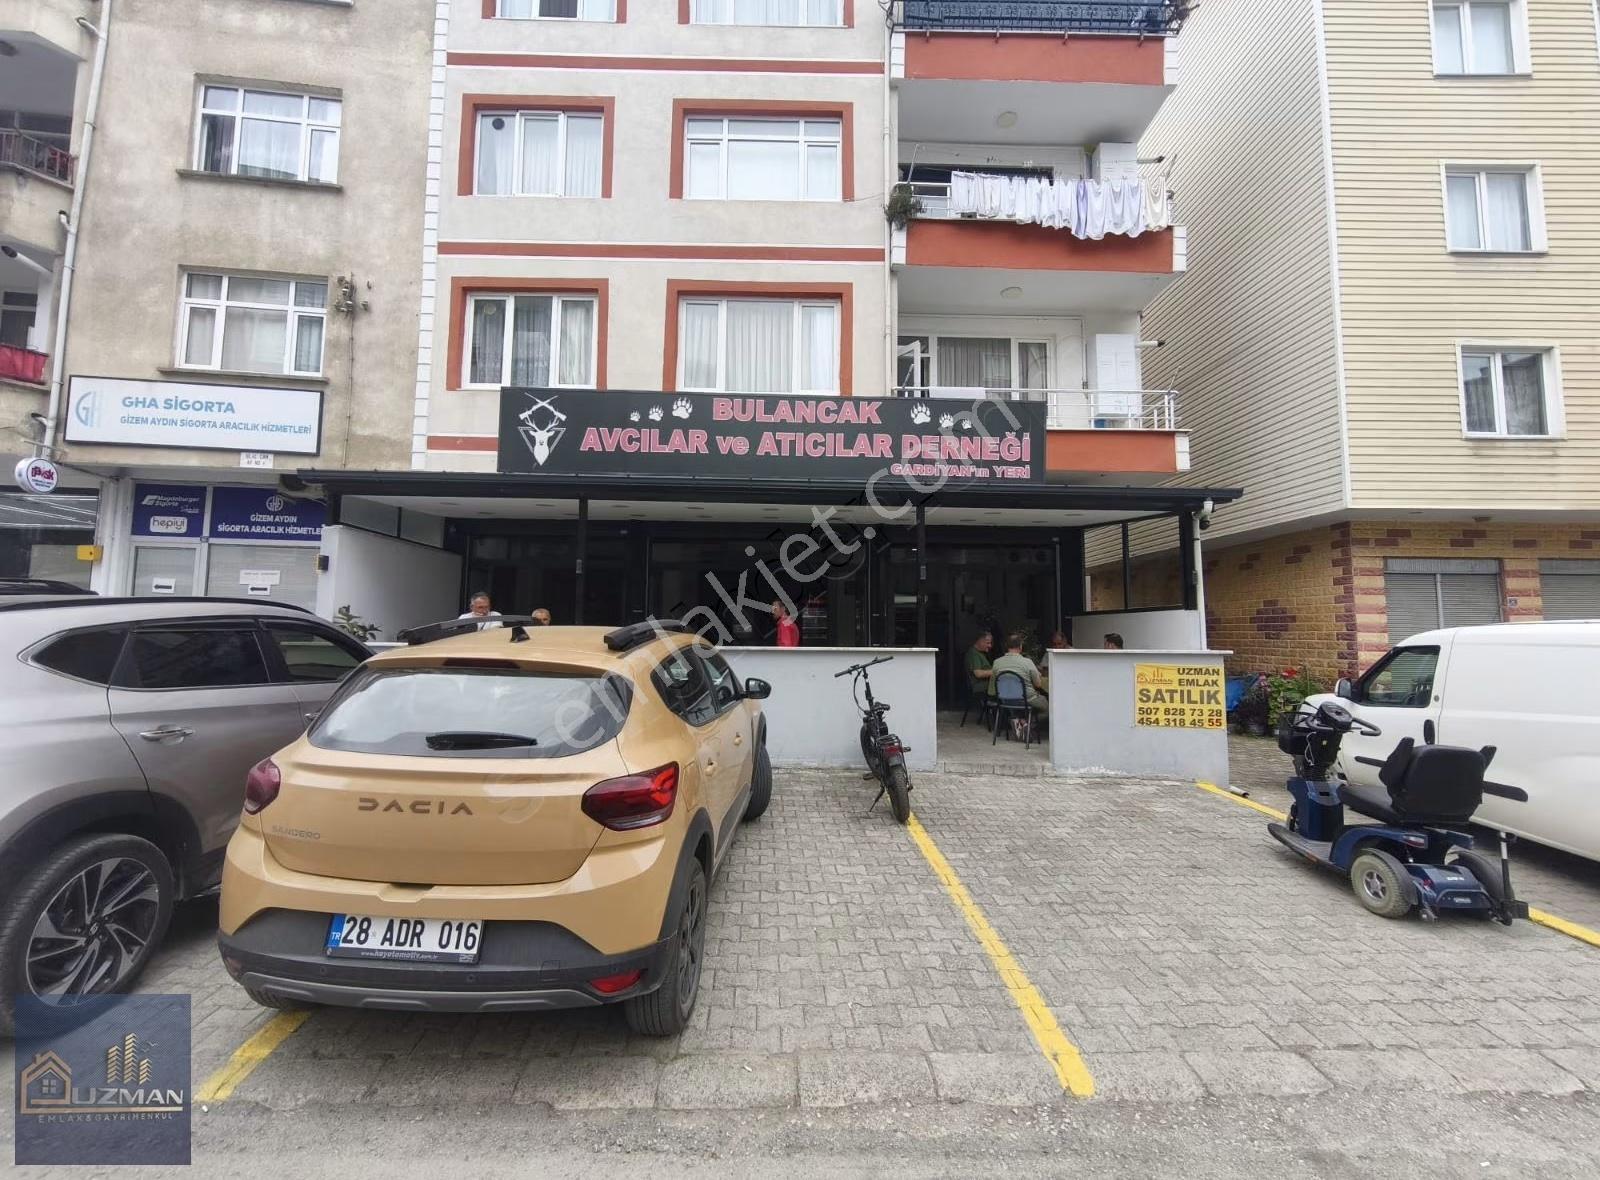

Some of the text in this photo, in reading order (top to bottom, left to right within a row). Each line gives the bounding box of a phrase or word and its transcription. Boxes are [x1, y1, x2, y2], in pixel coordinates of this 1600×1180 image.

[122, 395, 236, 414] GHA SİGORTA
[712, 397, 883, 425] BULANCAK
[120, 413, 313, 434] GİZEM AYDIN SİGORTA ARACILIK HİZMETLERİ
[580, 427, 1031, 462] AVCILAR ve ATICILAR DERNEĞİ
[991, 463, 1031, 480] YERİ
[250, 512, 298, 523] GİZEM AYDIN
[217, 522, 321, 535] SİGORTA ARACILIK HİZMETLE
[1177, 667, 1220, 676] UZMAN
[1178, 678, 1220, 687] EMLAK
[1138, 688, 1221, 705] SATILIK
[1137, 707, 1222, 717] 507 828 73 28
[1137, 717, 1222, 727] 454 318 45 55
[357, 797, 473, 816] DACIA
[271, 824, 321, 840] SANDERO
[330, 931, 341, 941] TR
[342, 916, 479, 951] 28 ADR 016
